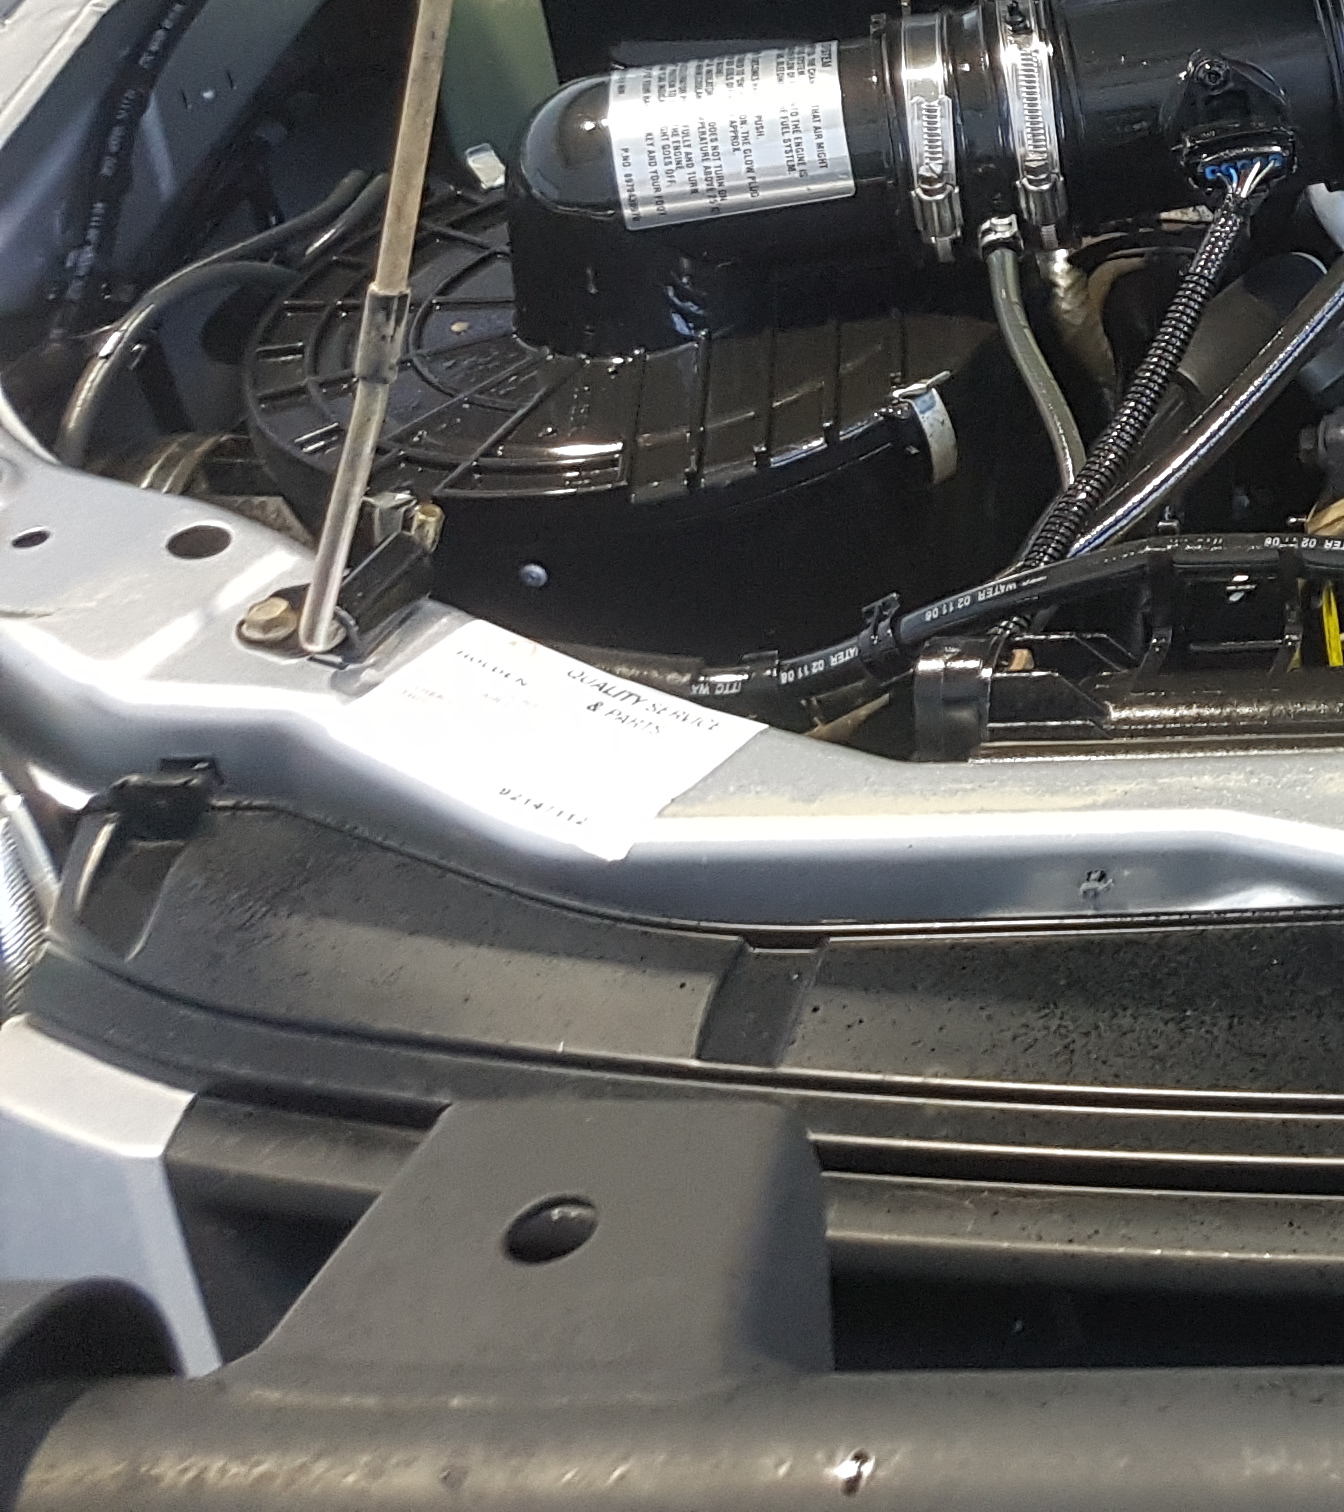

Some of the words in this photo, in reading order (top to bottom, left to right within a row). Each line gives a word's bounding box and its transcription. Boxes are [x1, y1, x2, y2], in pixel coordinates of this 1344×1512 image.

[1302, 537, 1317, 550] 02
[977, 580, 1017, 602] WATER
[957, 596, 972, 610] 02
[798, 664, 810, 680] 11
[811, 659, 825, 674] 02
[566, 667, 649, 706] QUALITY
[586, 700, 605, 714] &
[604, 707, 663, 735] PARTS
